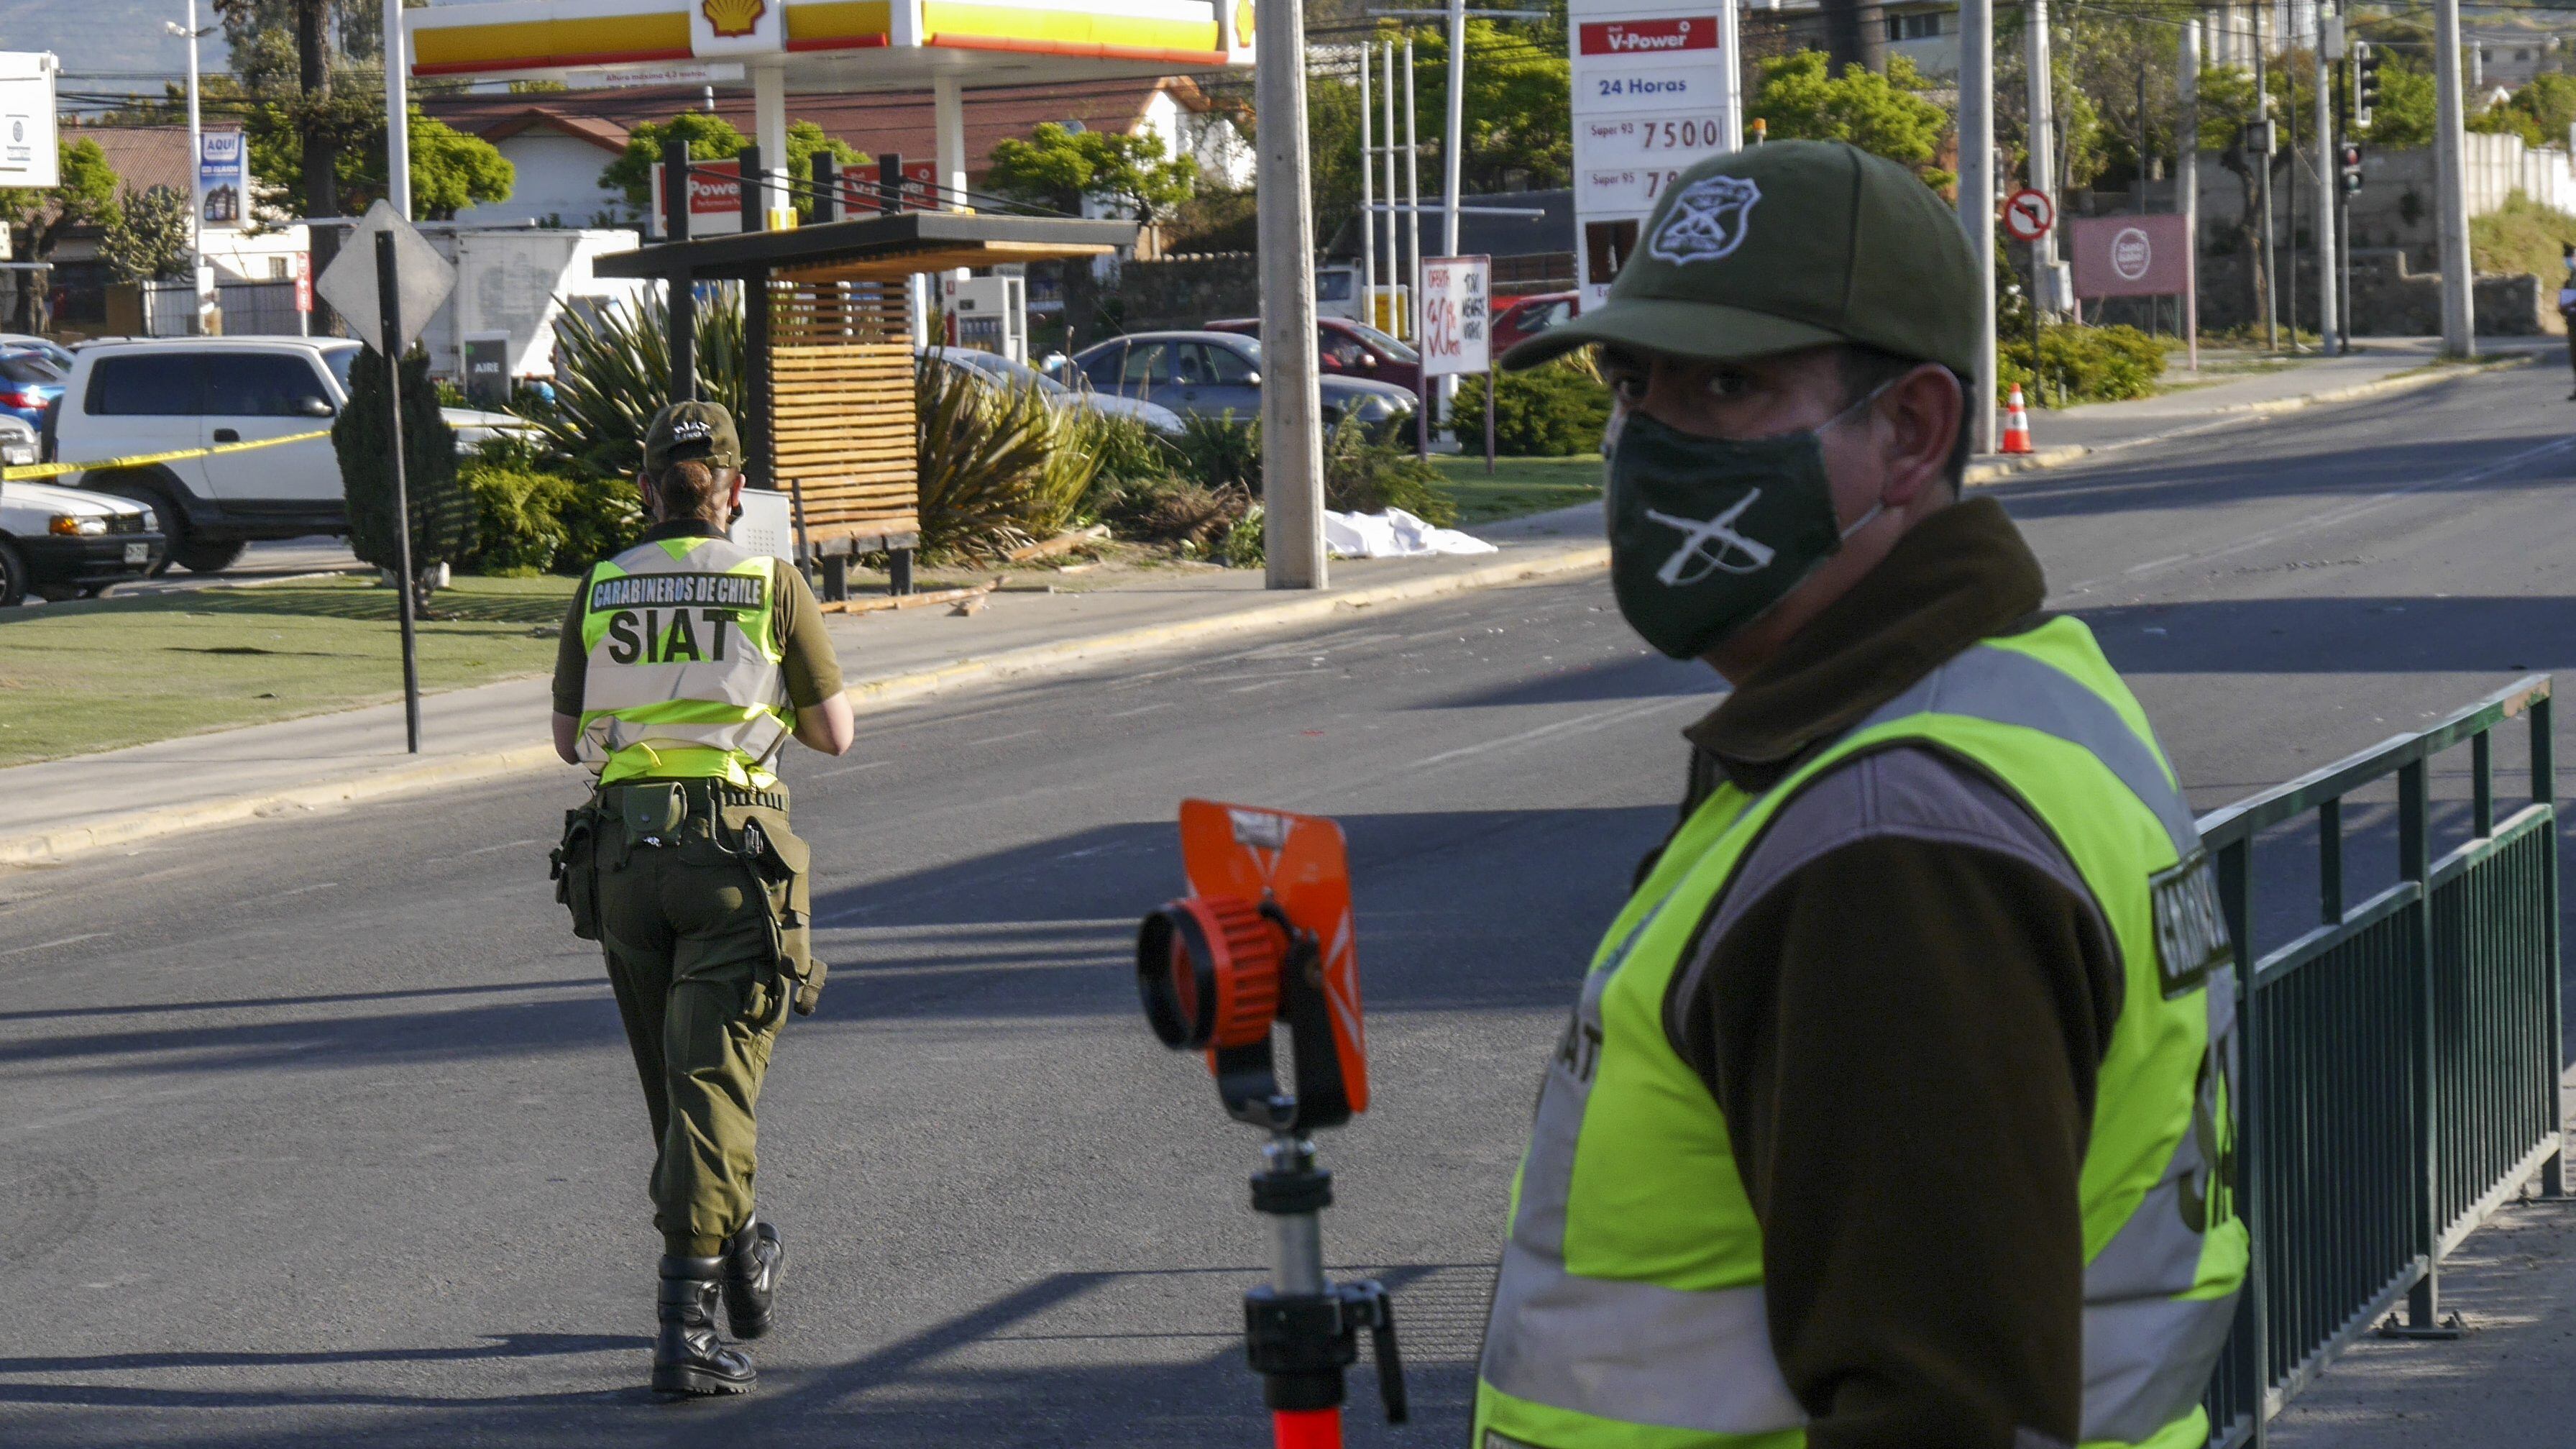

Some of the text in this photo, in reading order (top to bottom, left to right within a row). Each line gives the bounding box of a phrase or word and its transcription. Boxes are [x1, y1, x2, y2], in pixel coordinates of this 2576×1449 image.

[1608, 33, 1687, 50] V-Power
[1599, 78, 1687, 96] 24 Horas
[1590, 125, 1616, 138] Super
[1621, 122, 1634, 134] 93
[1592, 173, 1618, 186] Super
[1622, 172, 1635, 183] 95
[475, 362, 499, 373] AIRE
[594, 576, 761, 608] CARABINEROS DE CHILE
[608, 608, 738, 664] SIAT
